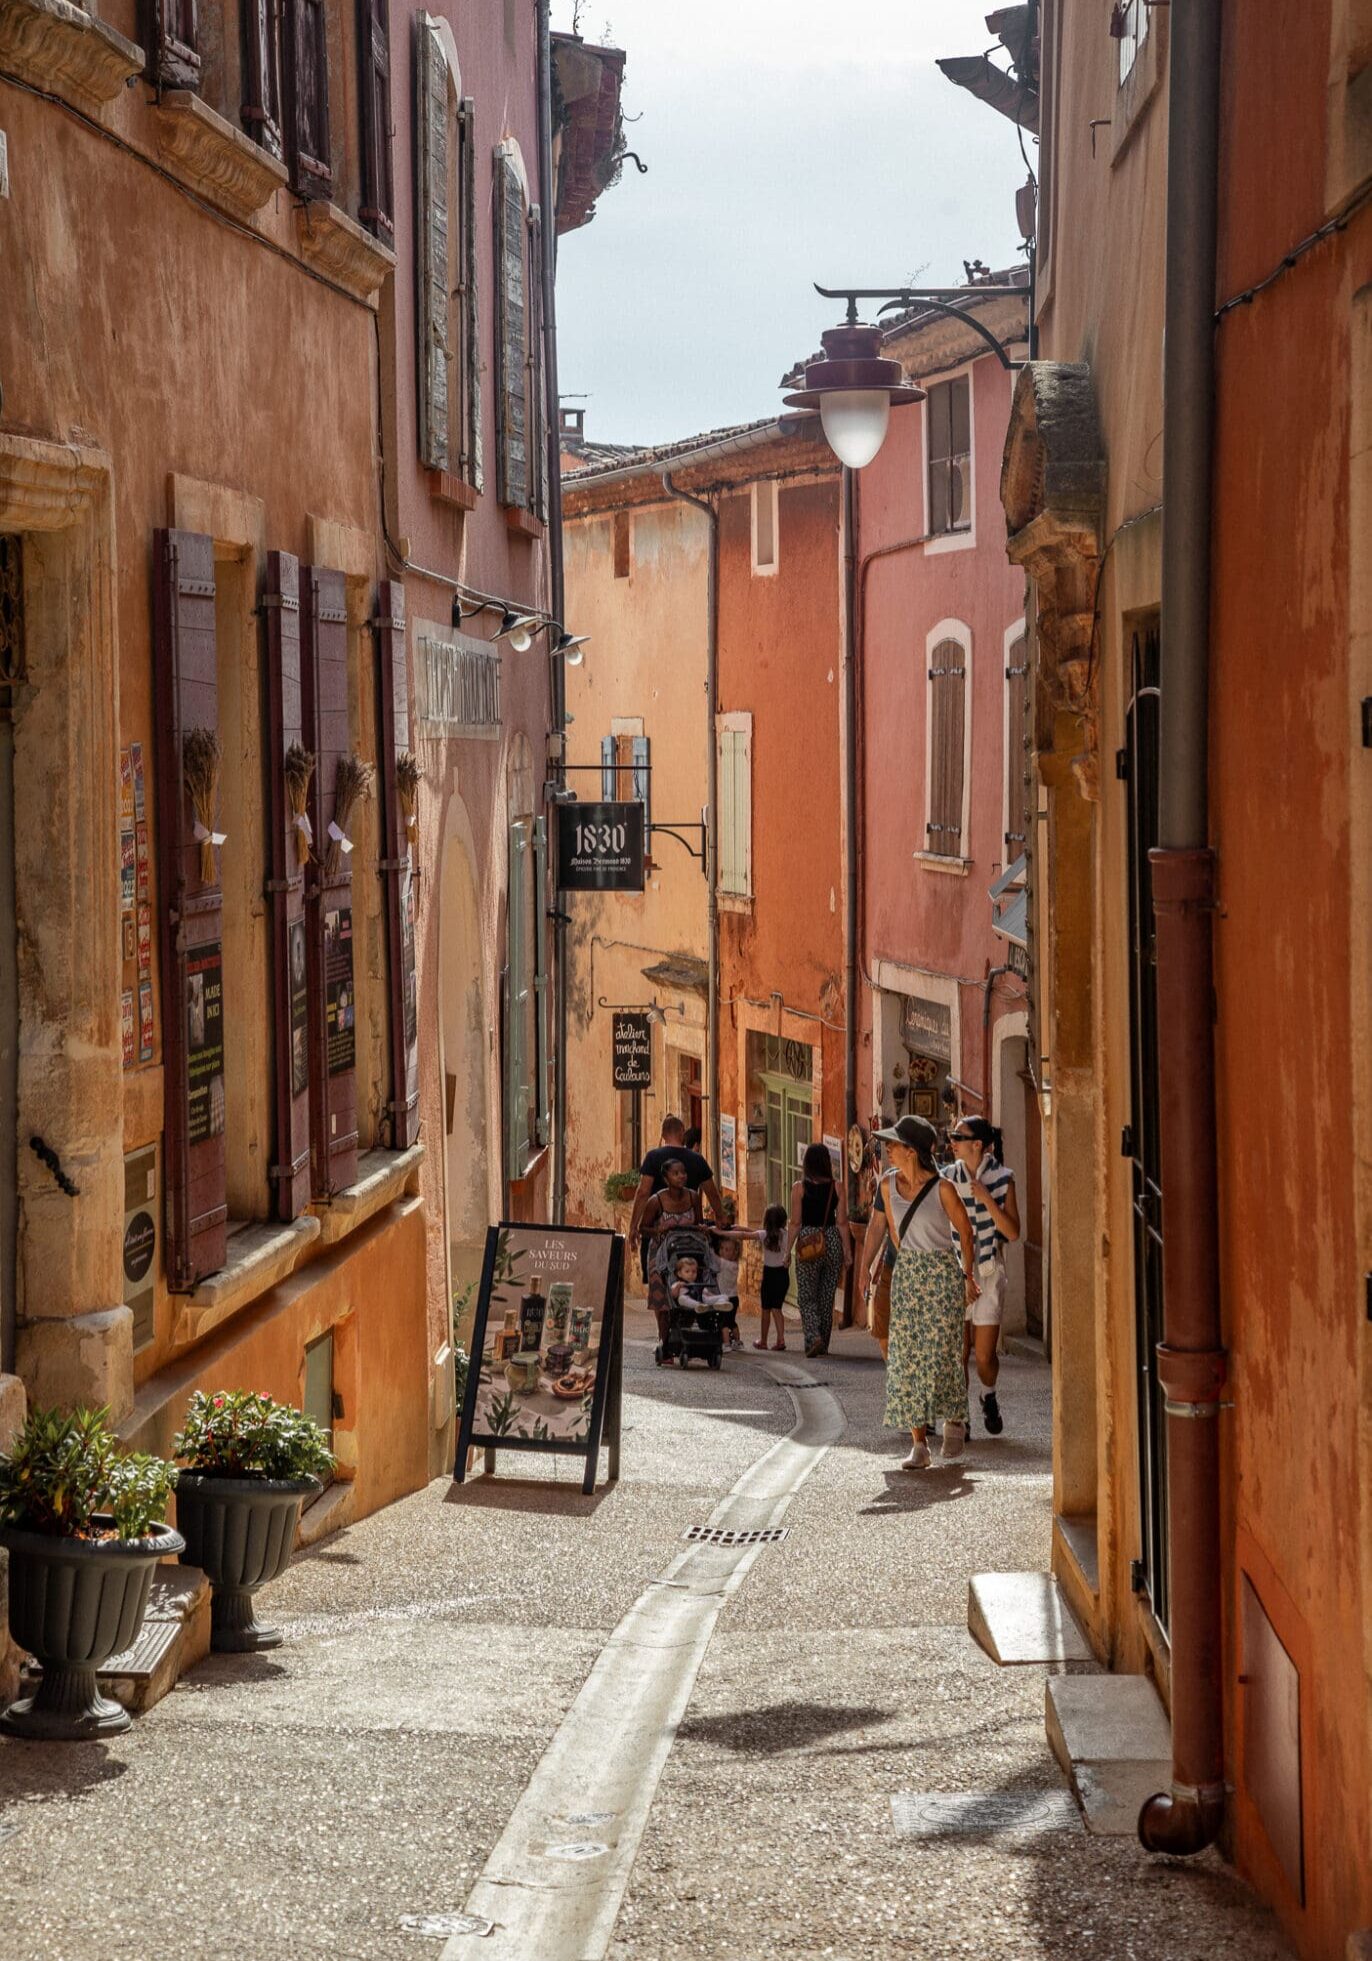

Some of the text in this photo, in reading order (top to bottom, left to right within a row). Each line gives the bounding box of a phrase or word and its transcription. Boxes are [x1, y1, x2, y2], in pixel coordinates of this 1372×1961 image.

[576, 824, 625, 855] 1830
[205, 984, 221, 1000] MADE
[615, 1022, 647, 1040] atelier
[616, 1039, 650, 1055] marchand
[627, 1054, 640, 1068] de
[545, 1240, 565, 1250] LES
[528, 1249, 578, 1261] SAVEURS
[534, 1260, 549, 1269] DU
[549, 1261, 570, 1271] SUD
